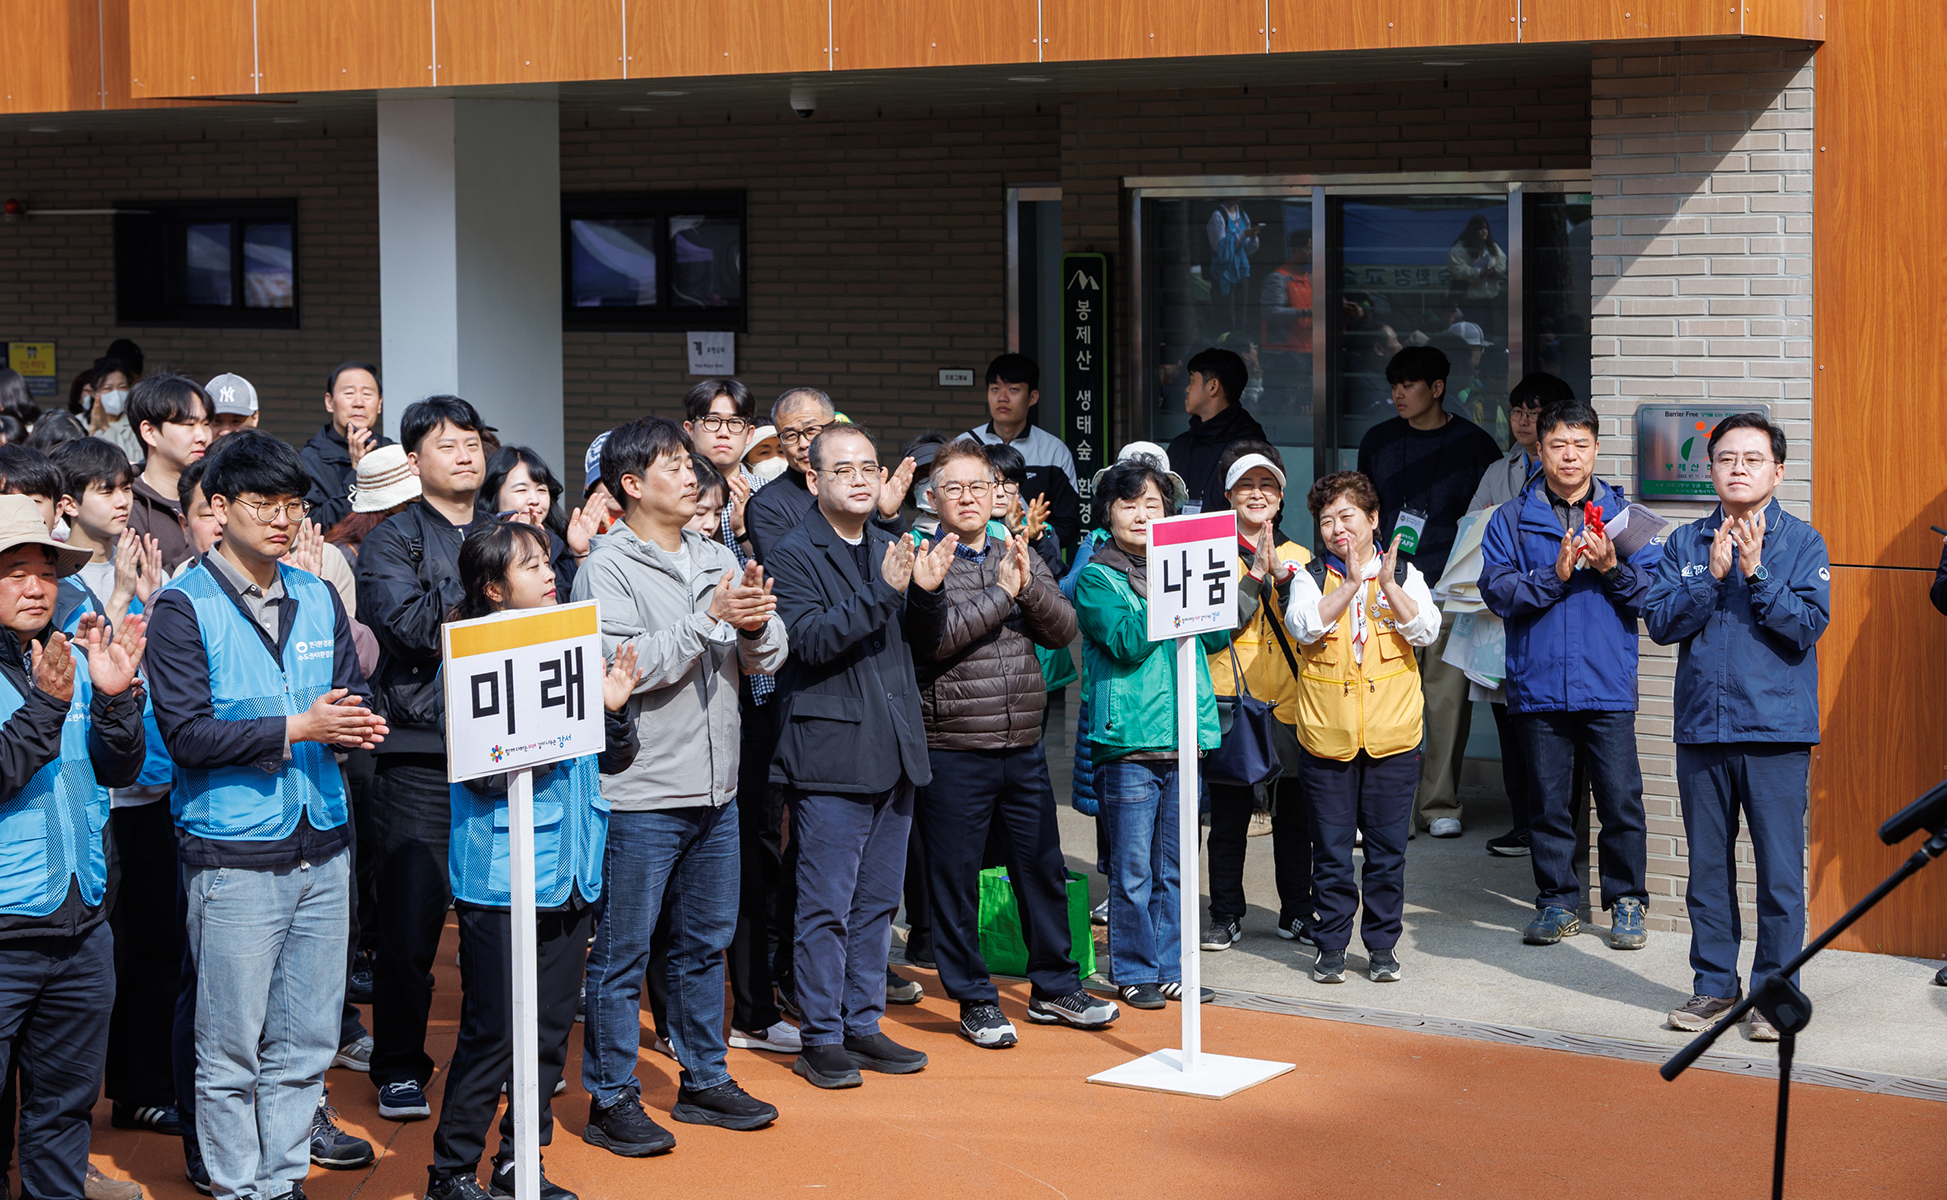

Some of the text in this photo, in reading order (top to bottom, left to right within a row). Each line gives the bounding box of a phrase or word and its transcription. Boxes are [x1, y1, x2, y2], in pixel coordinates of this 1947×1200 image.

[1076, 300, 1092, 371] 봉제산
[219, 385, 236, 403] NY
[1076, 390, 1092, 461] 생태숲
[1399, 538, 1415, 548] TAFF
[1163, 548, 1231, 608] 나눔
[470, 646, 584, 735] 미래
[557, 733, 572, 748] 강서
